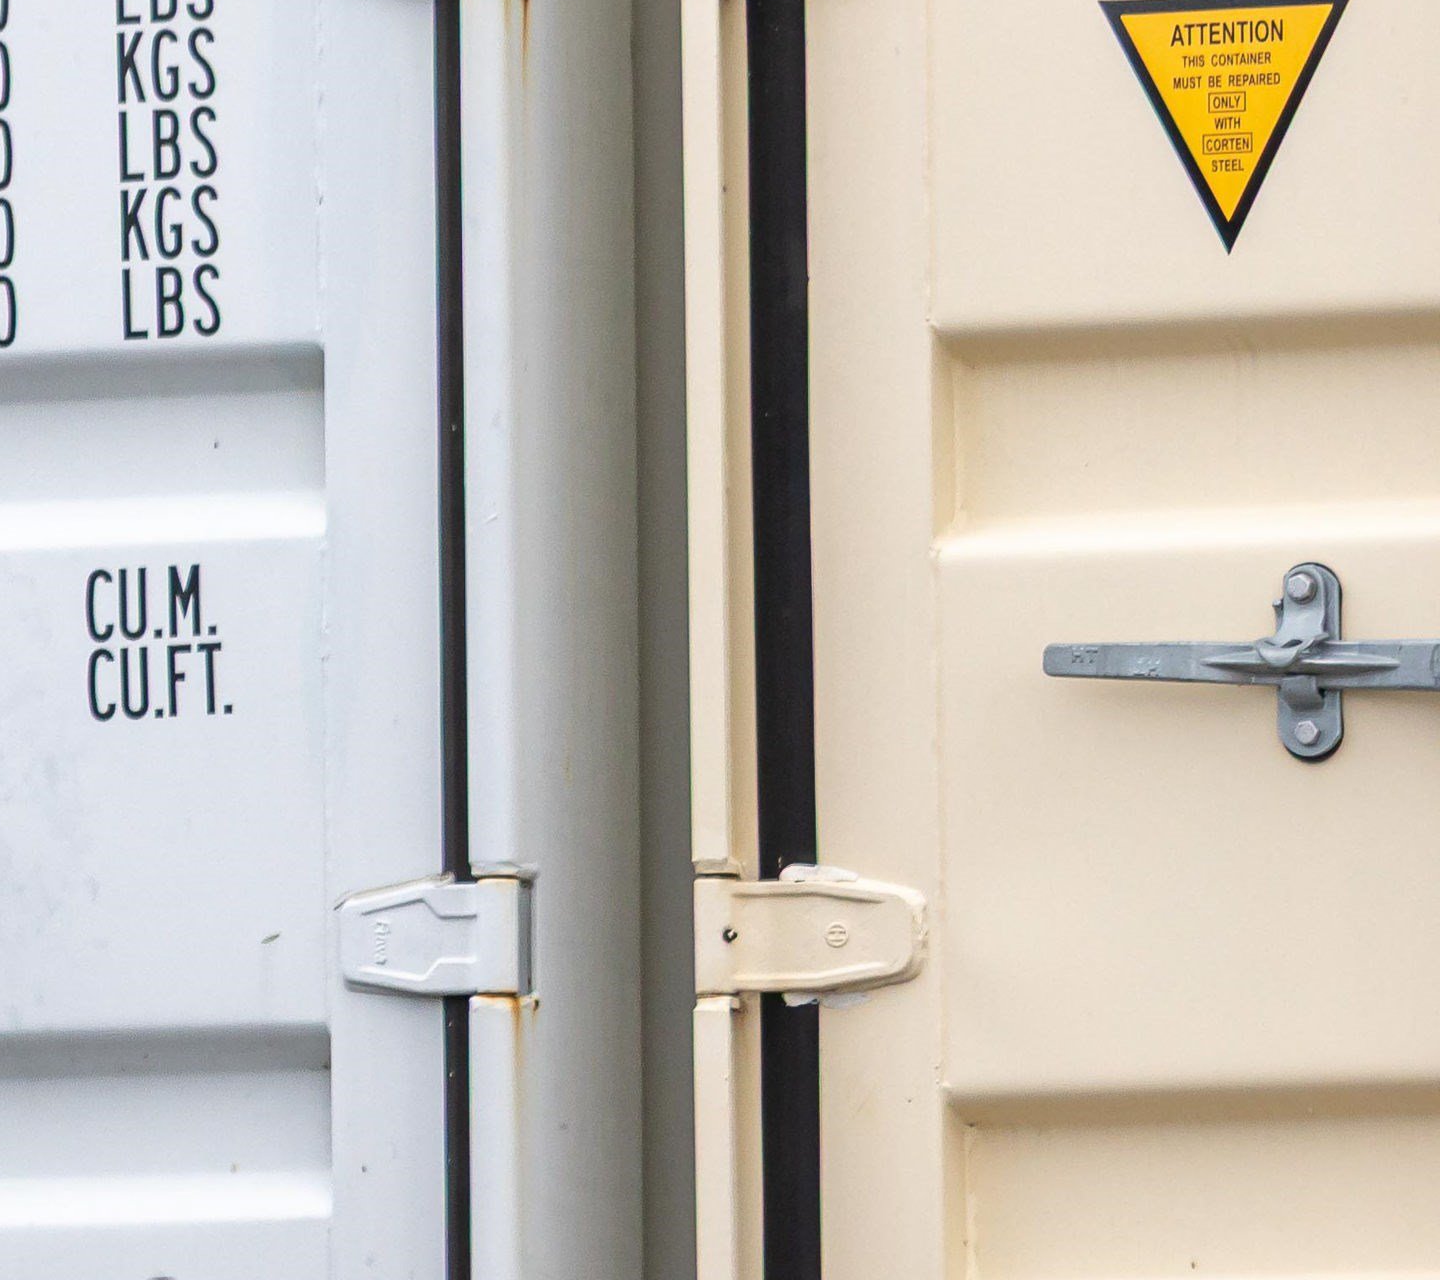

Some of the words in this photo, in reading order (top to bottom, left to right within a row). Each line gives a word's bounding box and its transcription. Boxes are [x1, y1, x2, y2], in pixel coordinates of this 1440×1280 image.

[1170, 18, 1284, 47] ATTENTION
[116, 29, 217, 106] KGS
[1182, 54, 1205, 68] THIS
[1211, 51, 1272, 67] CONTAINER
[1173, 75, 1202, 89] MUST
[1208, 75, 1222, 88] BE
[1229, 72, 1281, 86] REPAIRED
[1212, 95, 1241, 109] ONLY
[1214, 117, 1241, 130] WITH
[118, 106, 219, 183] LBS
[1206, 137, 1249, 152] CORTEN
[1211, 159, 1244, 172] STEEL
[119, 185, 221, 264] KGS
[121, 265, 223, 343] LBS
[86, 562, 219, 646] CU.M.
[88, 642, 234, 722] CU.FT.
